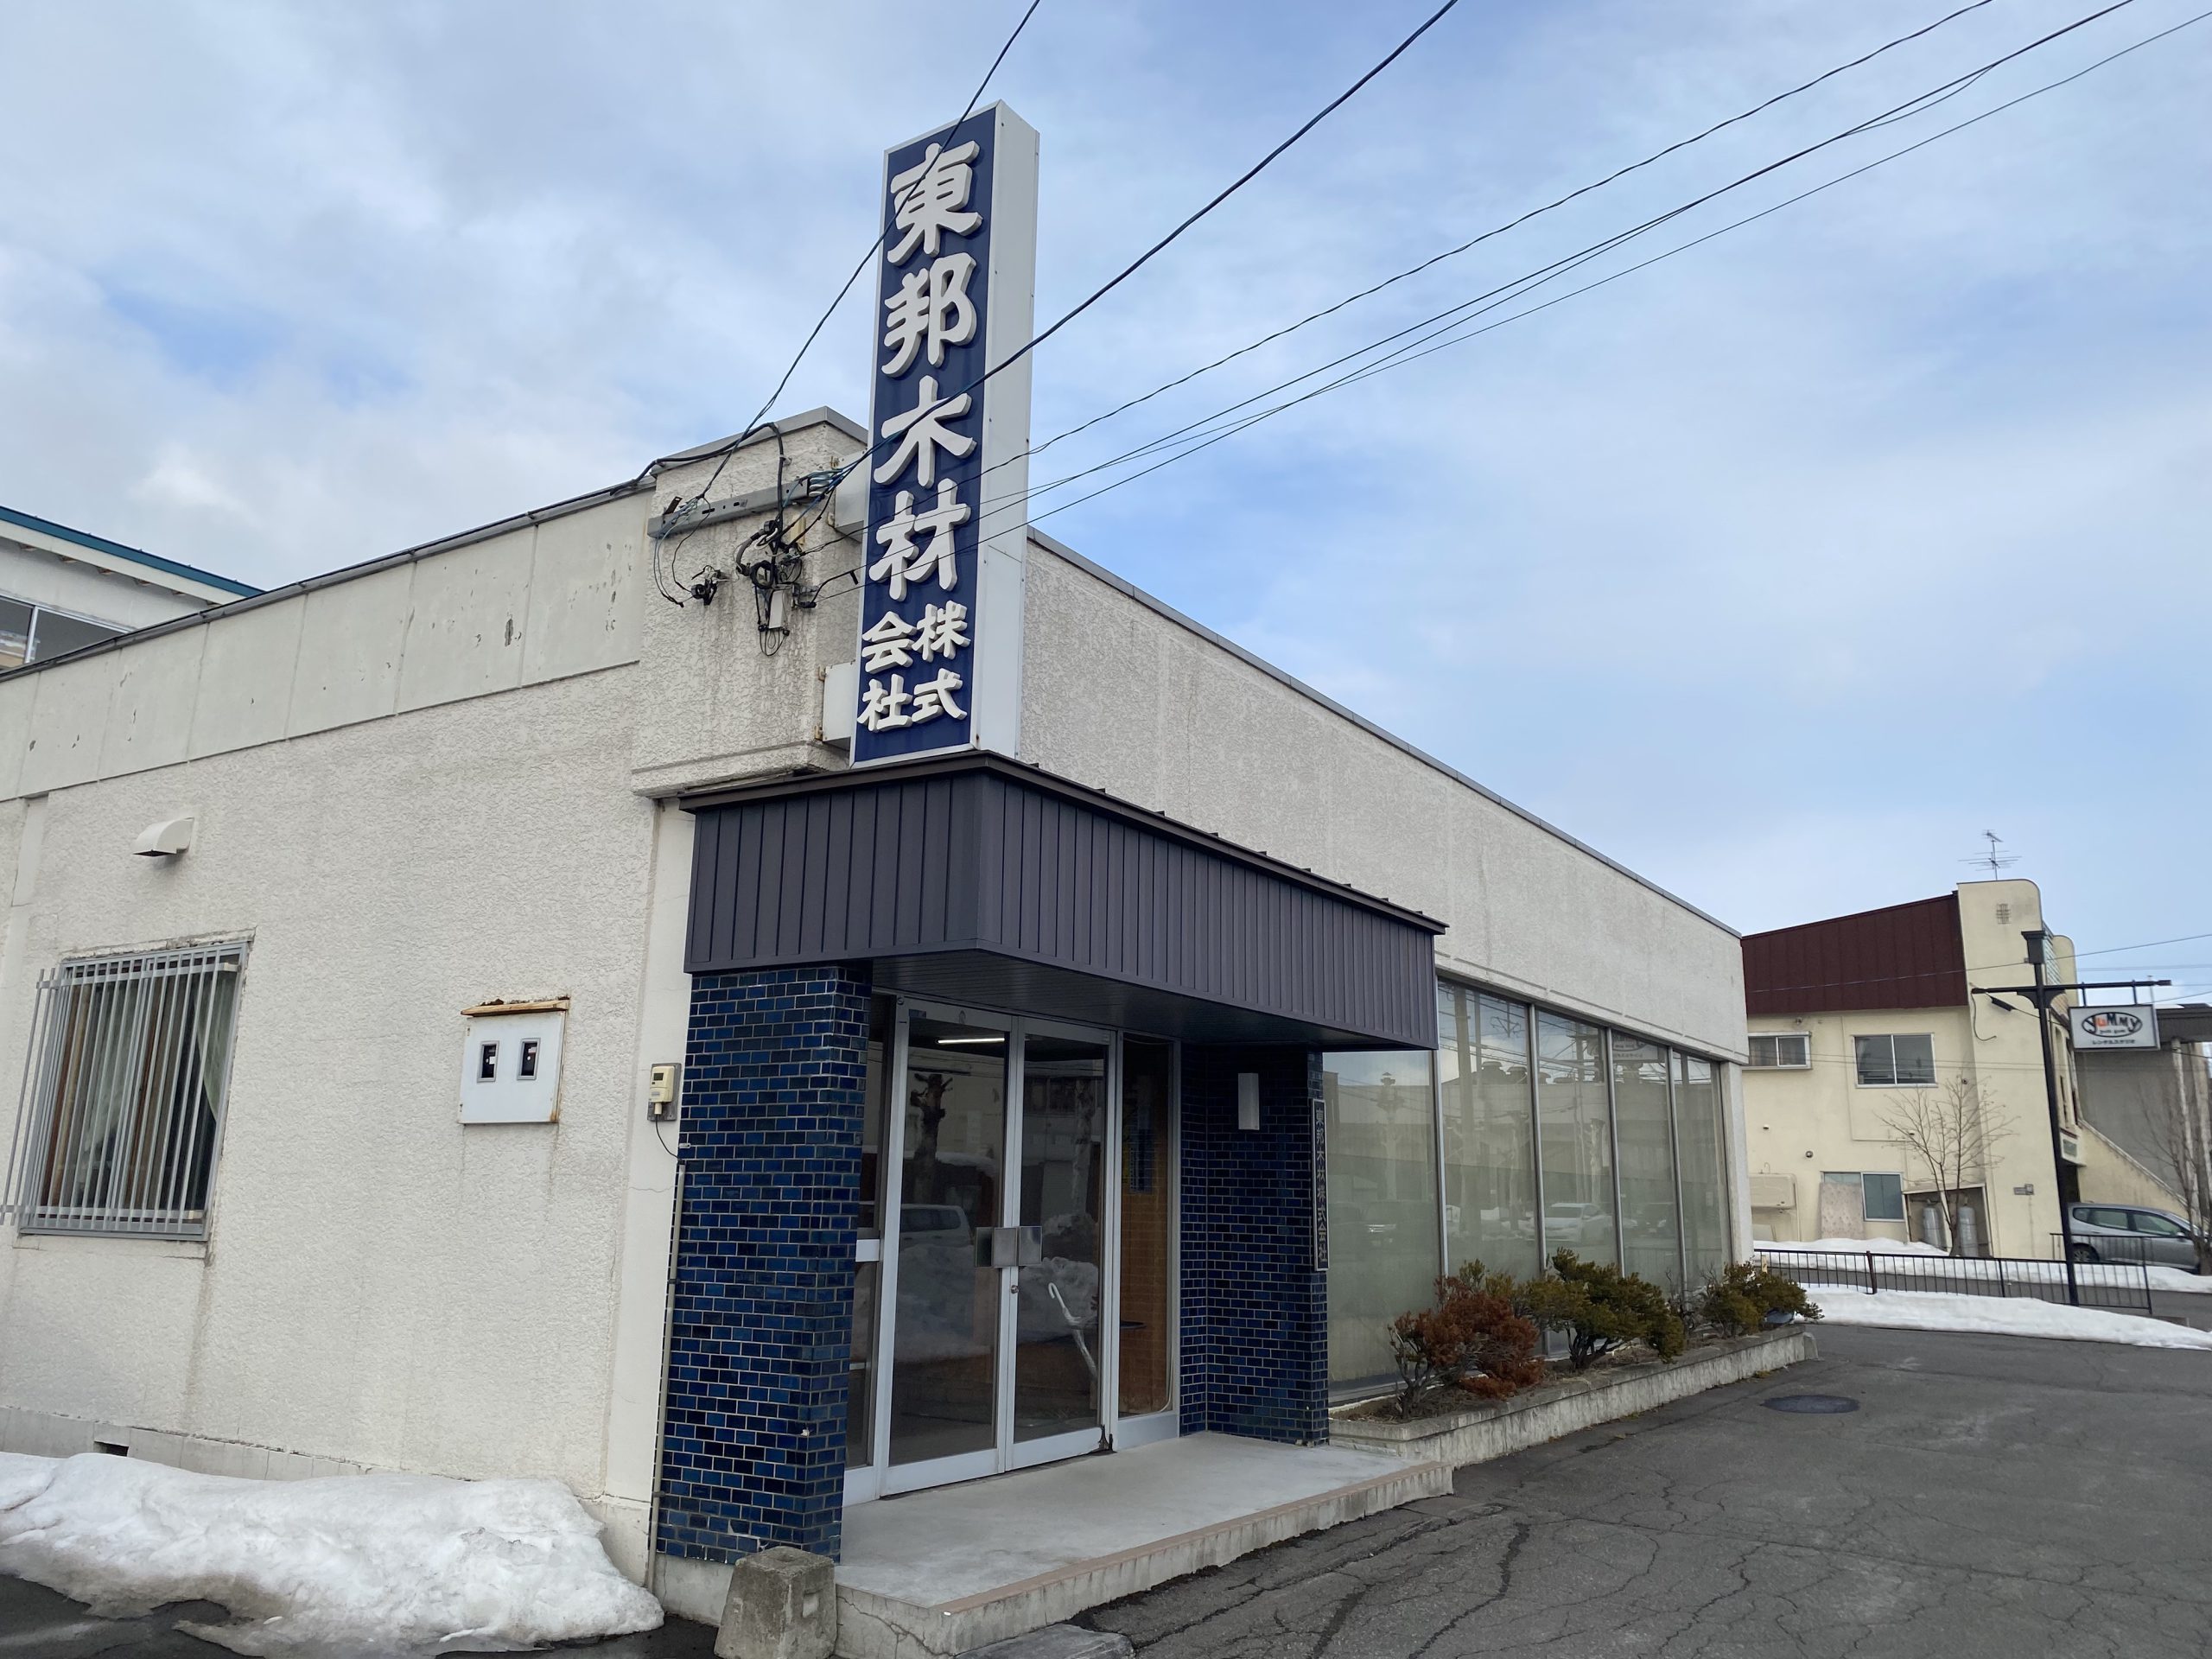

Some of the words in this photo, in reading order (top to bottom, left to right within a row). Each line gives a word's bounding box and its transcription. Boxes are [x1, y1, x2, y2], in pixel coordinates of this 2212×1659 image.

[869, 141, 983, 601] 東邦木材
[1315, 1109, 1327, 1262] 東邦木材株式会社
